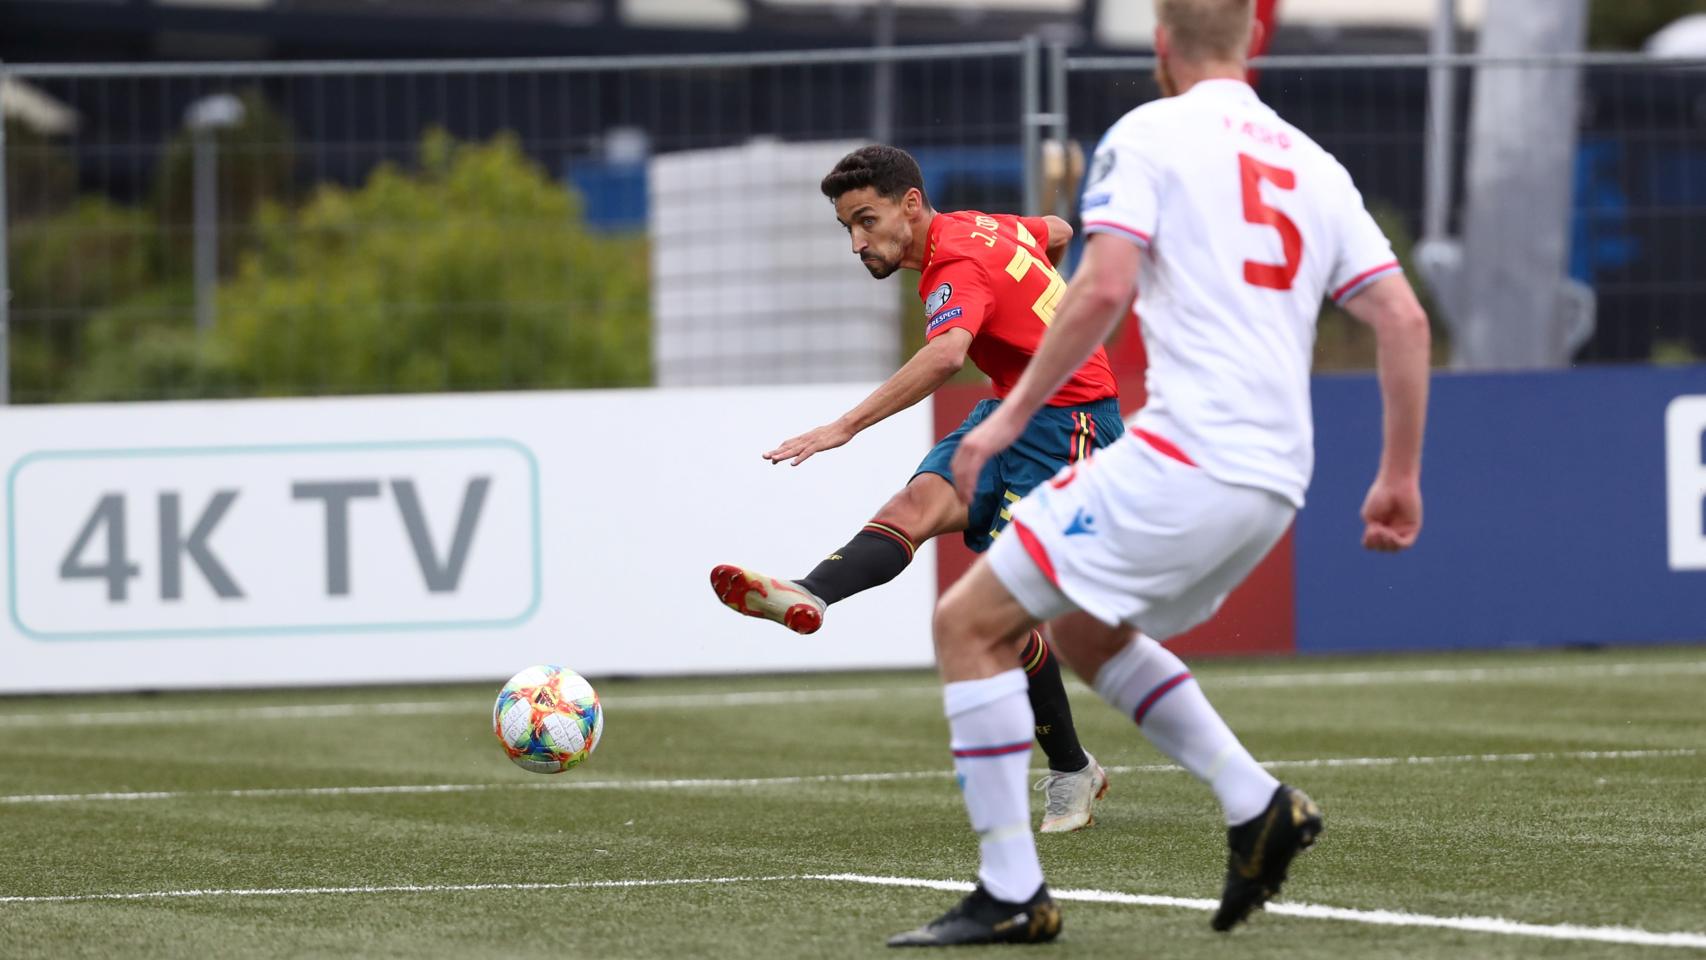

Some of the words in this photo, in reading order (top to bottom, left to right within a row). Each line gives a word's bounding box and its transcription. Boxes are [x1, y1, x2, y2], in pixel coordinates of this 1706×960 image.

[1239, 152, 1303, 291] 5
[931, 308, 961, 327] RESPECT
[58, 489, 247, 604] 4K
[291, 476, 493, 597] TV
